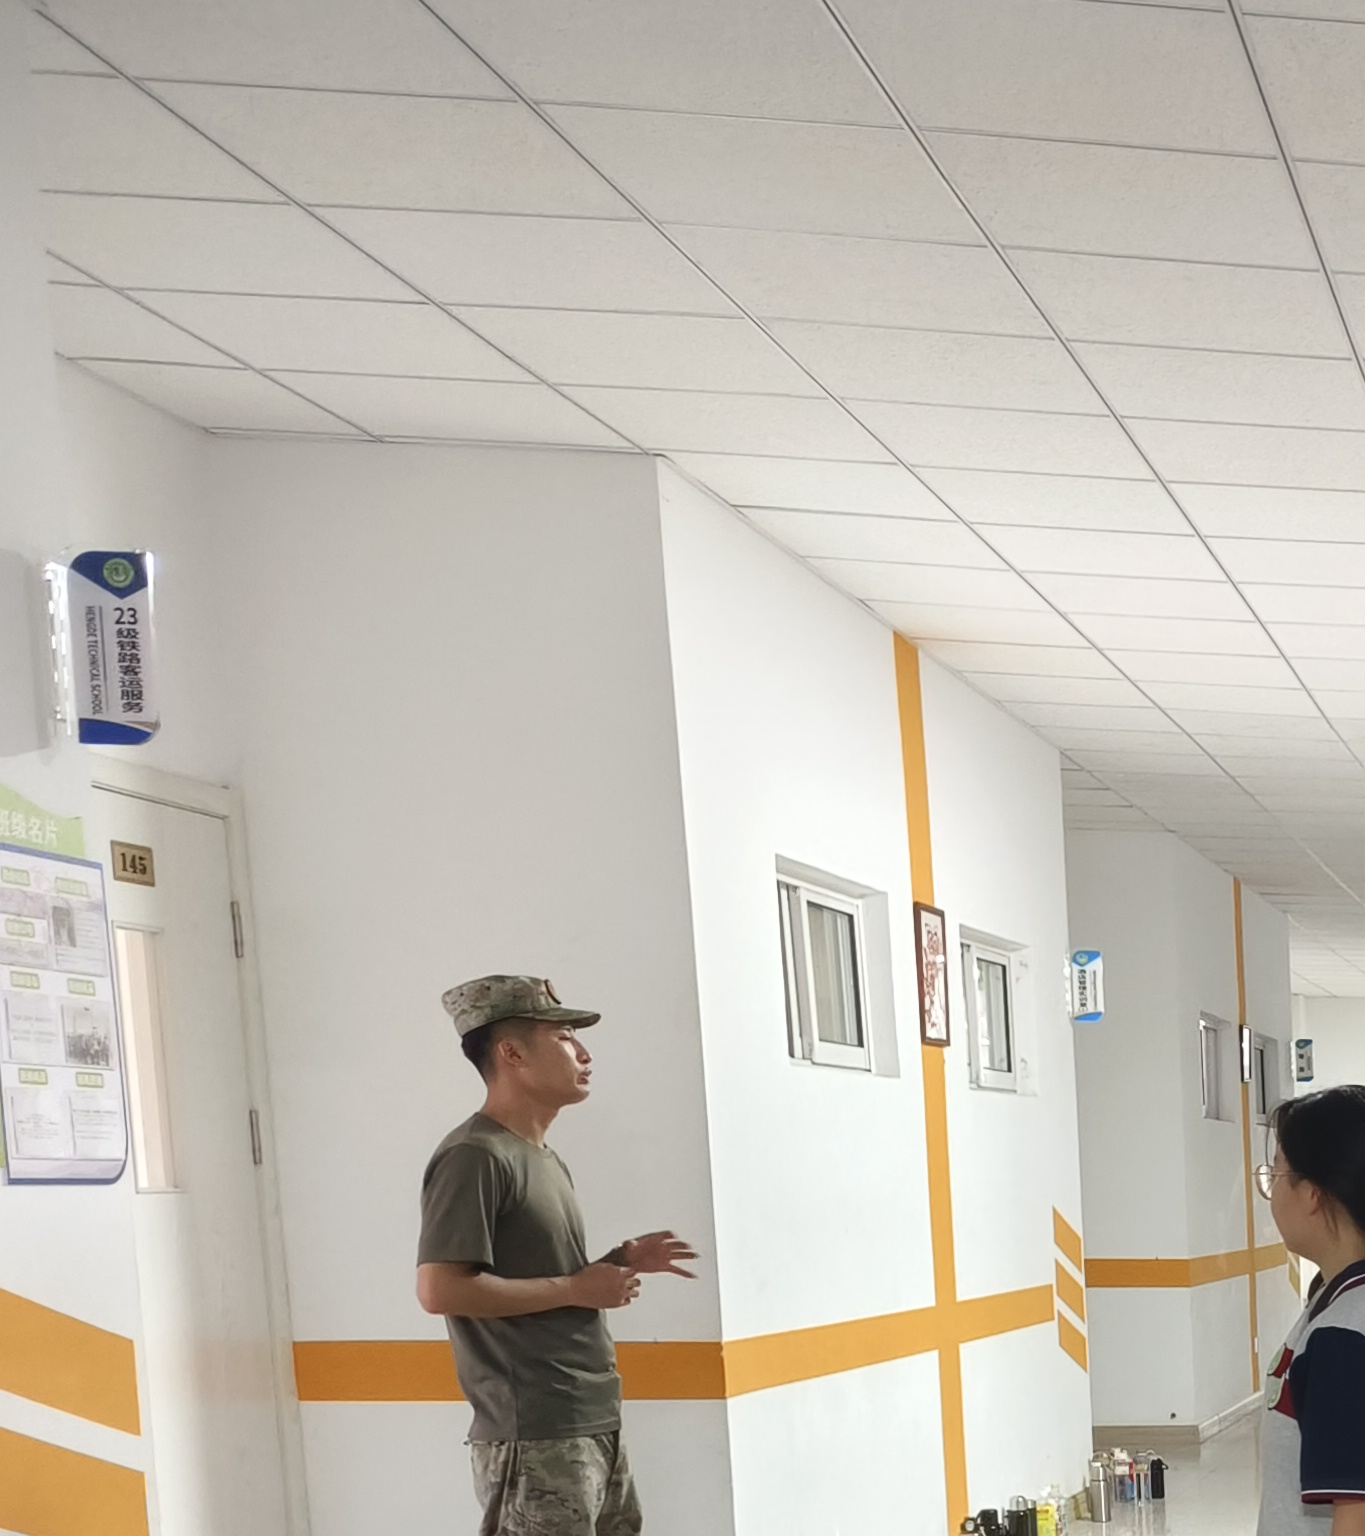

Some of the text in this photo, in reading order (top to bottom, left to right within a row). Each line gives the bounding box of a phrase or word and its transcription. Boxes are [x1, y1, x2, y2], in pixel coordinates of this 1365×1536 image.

[87, 639, 101, 682] TECHNICAL
[113, 607, 143, 714] 23级铁路客运服务
[90, 684, 103, 716] SCHOOL
[120, 852, 148, 876] 145
